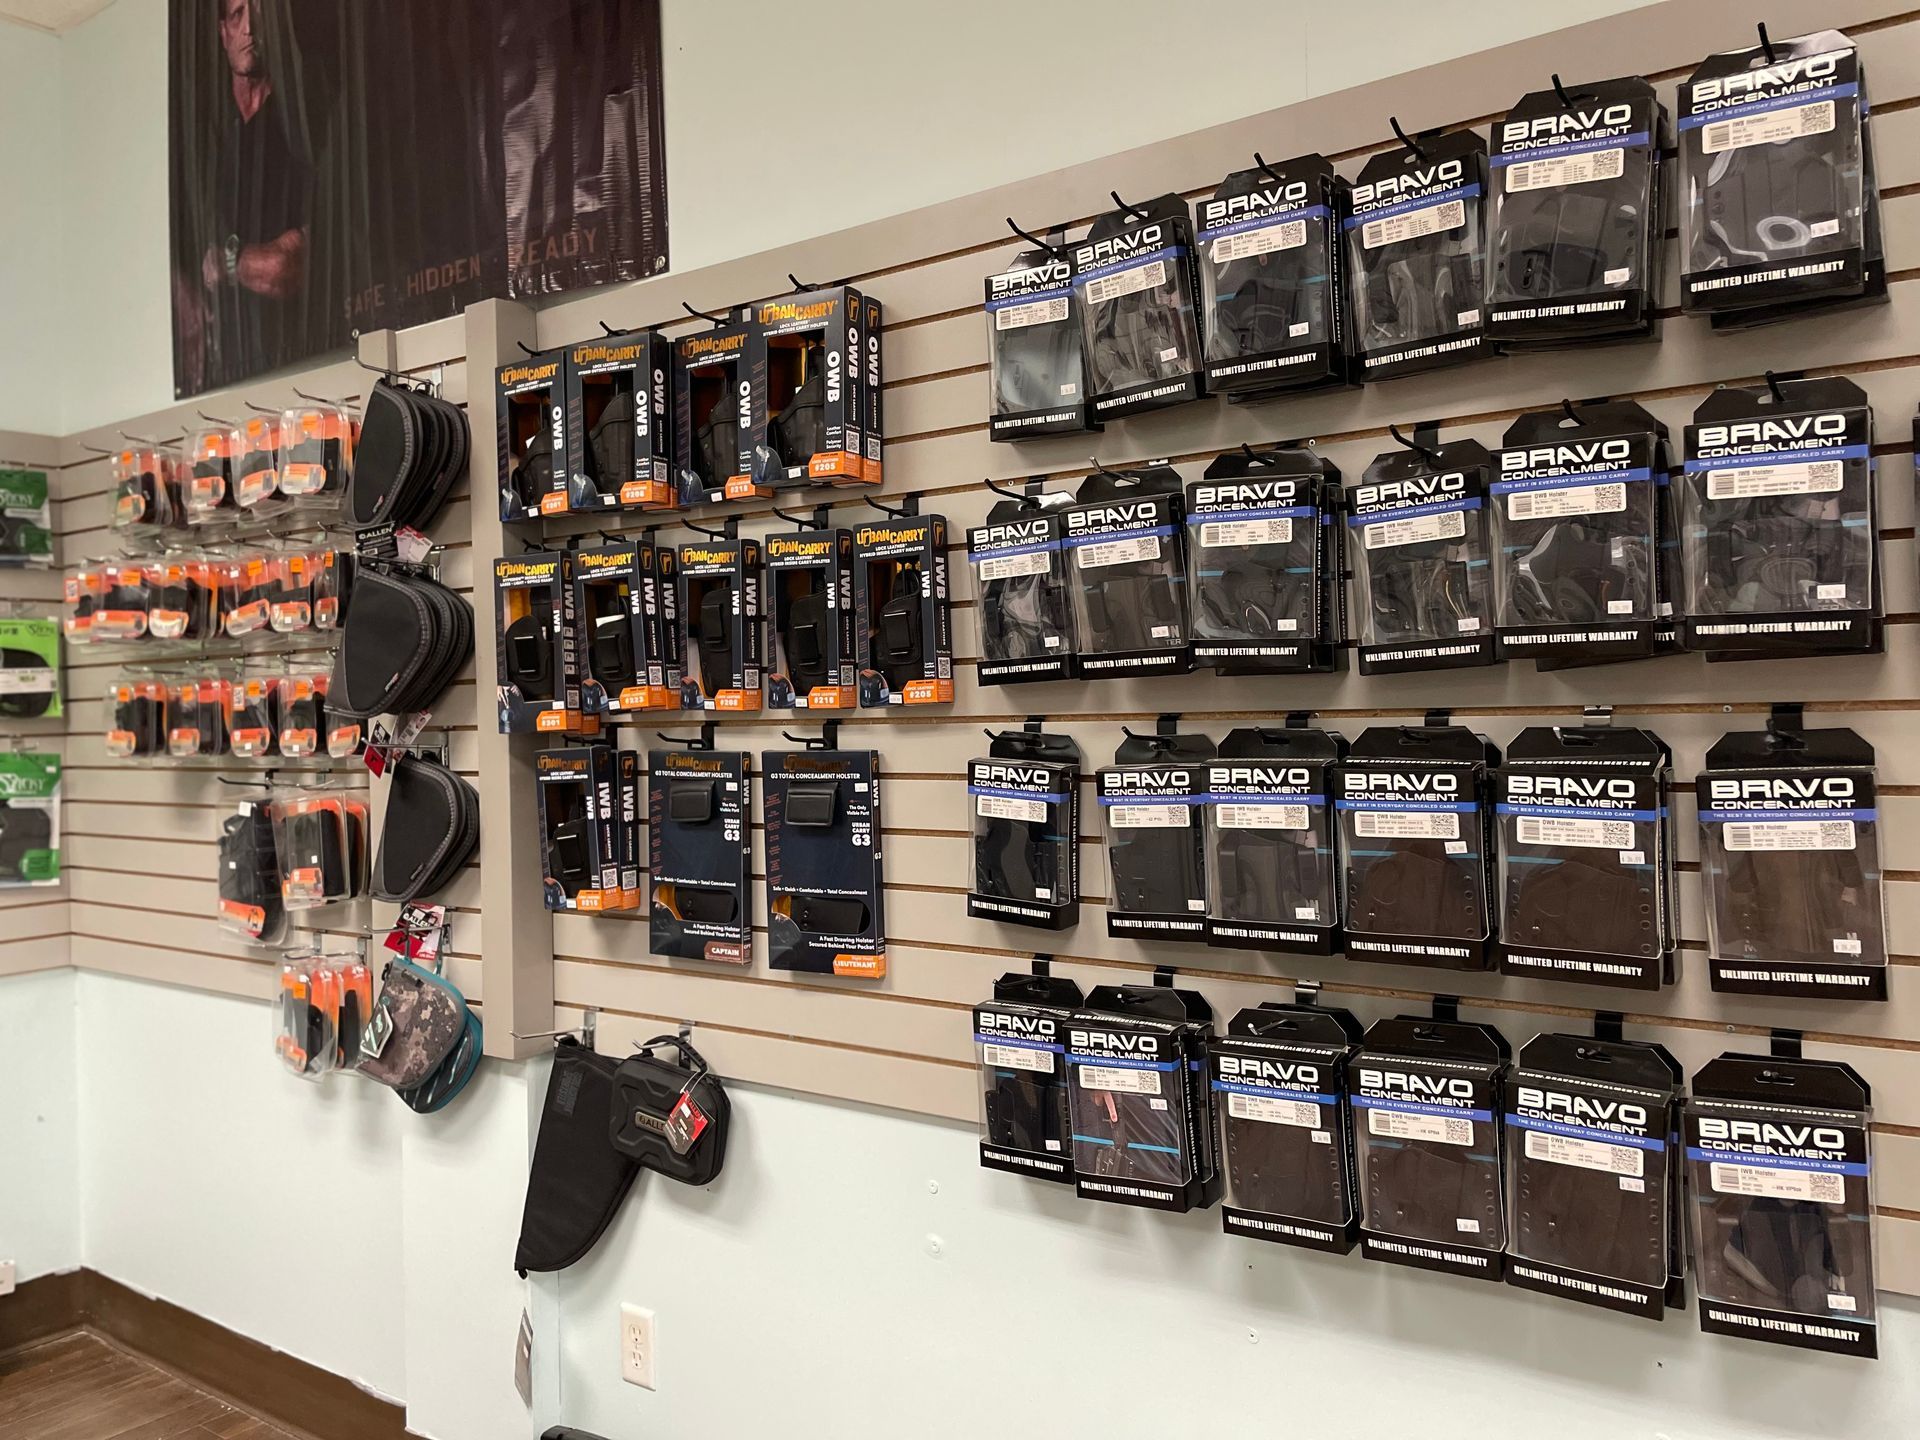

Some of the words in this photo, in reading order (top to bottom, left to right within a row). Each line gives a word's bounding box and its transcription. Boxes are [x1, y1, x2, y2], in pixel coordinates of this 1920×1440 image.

[1692, 52, 1836, 103] BRAVO
[1691, 75, 1837, 114] CONCEALMENT
[1503, 104, 1631, 142] BRAVO
[1501, 124, 1631, 153] CONCEALMENT
[1352, 160, 1461, 205] BRAVO
[1352, 178, 1463, 214] CONCEALMENT
[1205, 199, 1307, 229] CONCEALMENT
[1206, 181, 1306, 220] BRAVO
[1076, 224, 1161, 263] BRAVO
[1077, 241, 1163, 273] CONCEALMENT
[407, 253, 480, 298] HIDDEN
[512, 227, 597, 267] READY
[1690, 275, 1741, 292] UNLIMITED
[1743, 268, 1786, 284] LIFETIME
[1787, 259, 1844, 277] WARRANTY
[990, 263, 1070, 292] BRAVO
[991, 278, 1071, 300] CONCEALMENT
[848, 327, 859, 379] OWB
[868, 336, 879, 387] OWB
[1211, 364, 1246, 377] UNLIMITED
[1247, 358, 1277, 371] LIFETIME
[1277, 352, 1316, 366] WARRANTY
[827, 350, 841, 402] OWB
[654, 369, 664, 415] OWB
[636, 390, 648, 437] OWB
[553, 406, 562, 450] OWB
[1698, 414, 1845, 447] BRAVO
[1501, 439, 1629, 470] BRAVO
[1697, 435, 1847, 458] CONCEALMENT
[1500, 459, 1630, 481] CONCEALMENT
[1195, 479, 1295, 504] BRAVO
[1356, 472, 1463, 505] BRAVO
[1356, 490, 1465, 514] CONCEALMENT
[1068, 502, 1156, 528] BRAVO
[1195, 498, 1296, 513] CONCEALMENT
[973, 519, 1048, 544] BRAVO
[1068, 518, 1158, 536] CONCEALMENT
[973, 534, 1049, 552] CONCEALMENT
[921, 571, 930, 598] IWB
[935, 556, 946, 599] IWB
[564, 584, 575, 620] IWB
[644, 577, 655, 615] IWB
[663, 582, 675, 620] IWB
[746, 577, 757, 617] IWB
[827, 582, 835, 609] IWB
[1695, 623, 1748, 634] UNLIMITED
[1748, 622, 1792, 633] LIFETIME
[1793, 620, 1851, 631] WARRANTY
[973, 779, 1050, 792] CONCEALMENT
[974, 764, 1049, 784] BRAVO
[1104, 771, 1189, 787] BRAVO
[1209, 767, 1309, 784] BRAVO
[1344, 773, 1456, 791] BRAVO
[1507, 775, 1634, 797] BRAVO
[1710, 777, 1853, 798] BRAVO
[599, 782, 611, 819] IWB
[1104, 787, 1191, 795] CONCEALMENT
[1209, 785, 1310, 794] CONCEALMENT
[1344, 791, 1458, 801] CONCEALMENT
[1507, 795, 1636, 809] CONCEALMENT
[586, 796, 594, 820] IWB
[623, 786, 634, 822] IWB
[1711, 799, 1855, 809] CONCEALMENT
[724, 830, 740, 841] G3
[852, 834, 871, 846] G3
[711, 947, 739, 955] CAPTAIN
[834, 960, 876, 968] LIEUTENANT
[1507, 954, 1552, 967] UNLIMITED
[1553, 959, 1591, 971] LIFETIME
[1592, 962, 1642, 976] WARRANTY
[979, 1011, 1054, 1034] BRAVO
[979, 1027, 1055, 1042] CONCEALMENT
[1070, 1030, 1157, 1052] BRAVO
[1070, 1047, 1158, 1061] CONCEALMENT
[1219, 1056, 1318, 1083] BRAVO
[1219, 1073, 1319, 1092] CONCEALMENT
[1359, 1068, 1473, 1097] BRAVO
[1359, 1088, 1474, 1108] CONCEALMENT
[1517, 1086, 1646, 1125] BRAVO
[1516, 1106, 1647, 1135] CONCEALMENT
[1698, 1117, 1844, 1149] BRAVO
[1699, 1139, 1846, 1161] CONCEALMENT
[1513, 1264, 1558, 1283] UNLIMITED
[1559, 1276, 1596, 1292] LIFETIME
[1598, 1285, 1647, 1304] WARRANTY
[1708, 1309, 1759, 1326] UNLIMITED
[1760, 1318, 1803, 1333] LIFETIME
[1804, 1324, 1859, 1341] WARRANTY
